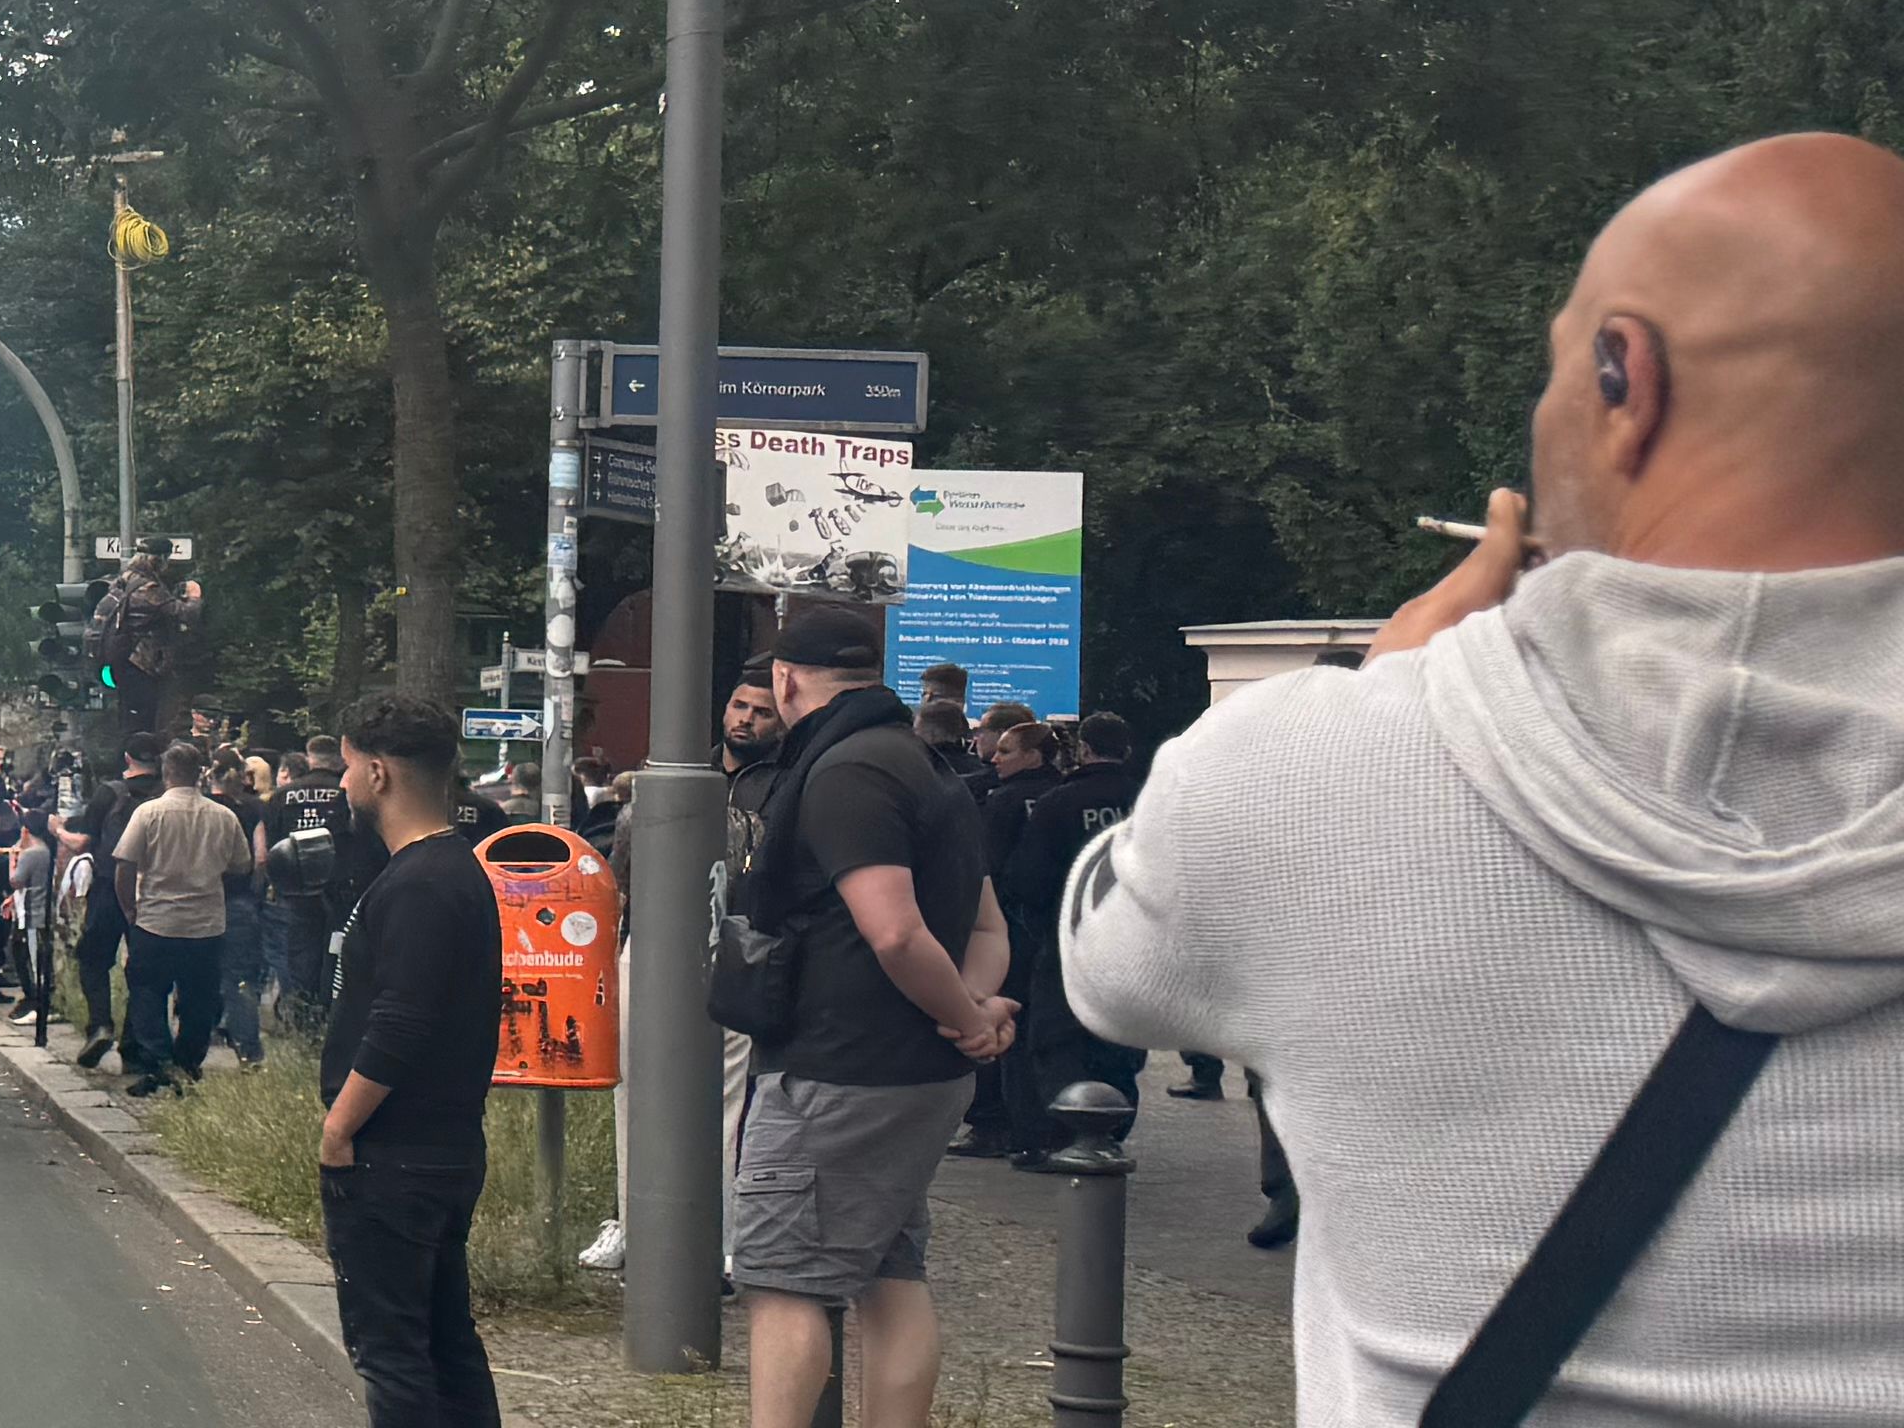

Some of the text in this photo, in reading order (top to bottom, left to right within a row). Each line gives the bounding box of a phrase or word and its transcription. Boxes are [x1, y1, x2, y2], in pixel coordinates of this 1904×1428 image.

[742, 380, 826, 398] Körnerpark
[750, 431, 825, 456] Death
[835, 439, 910, 468] Traps
